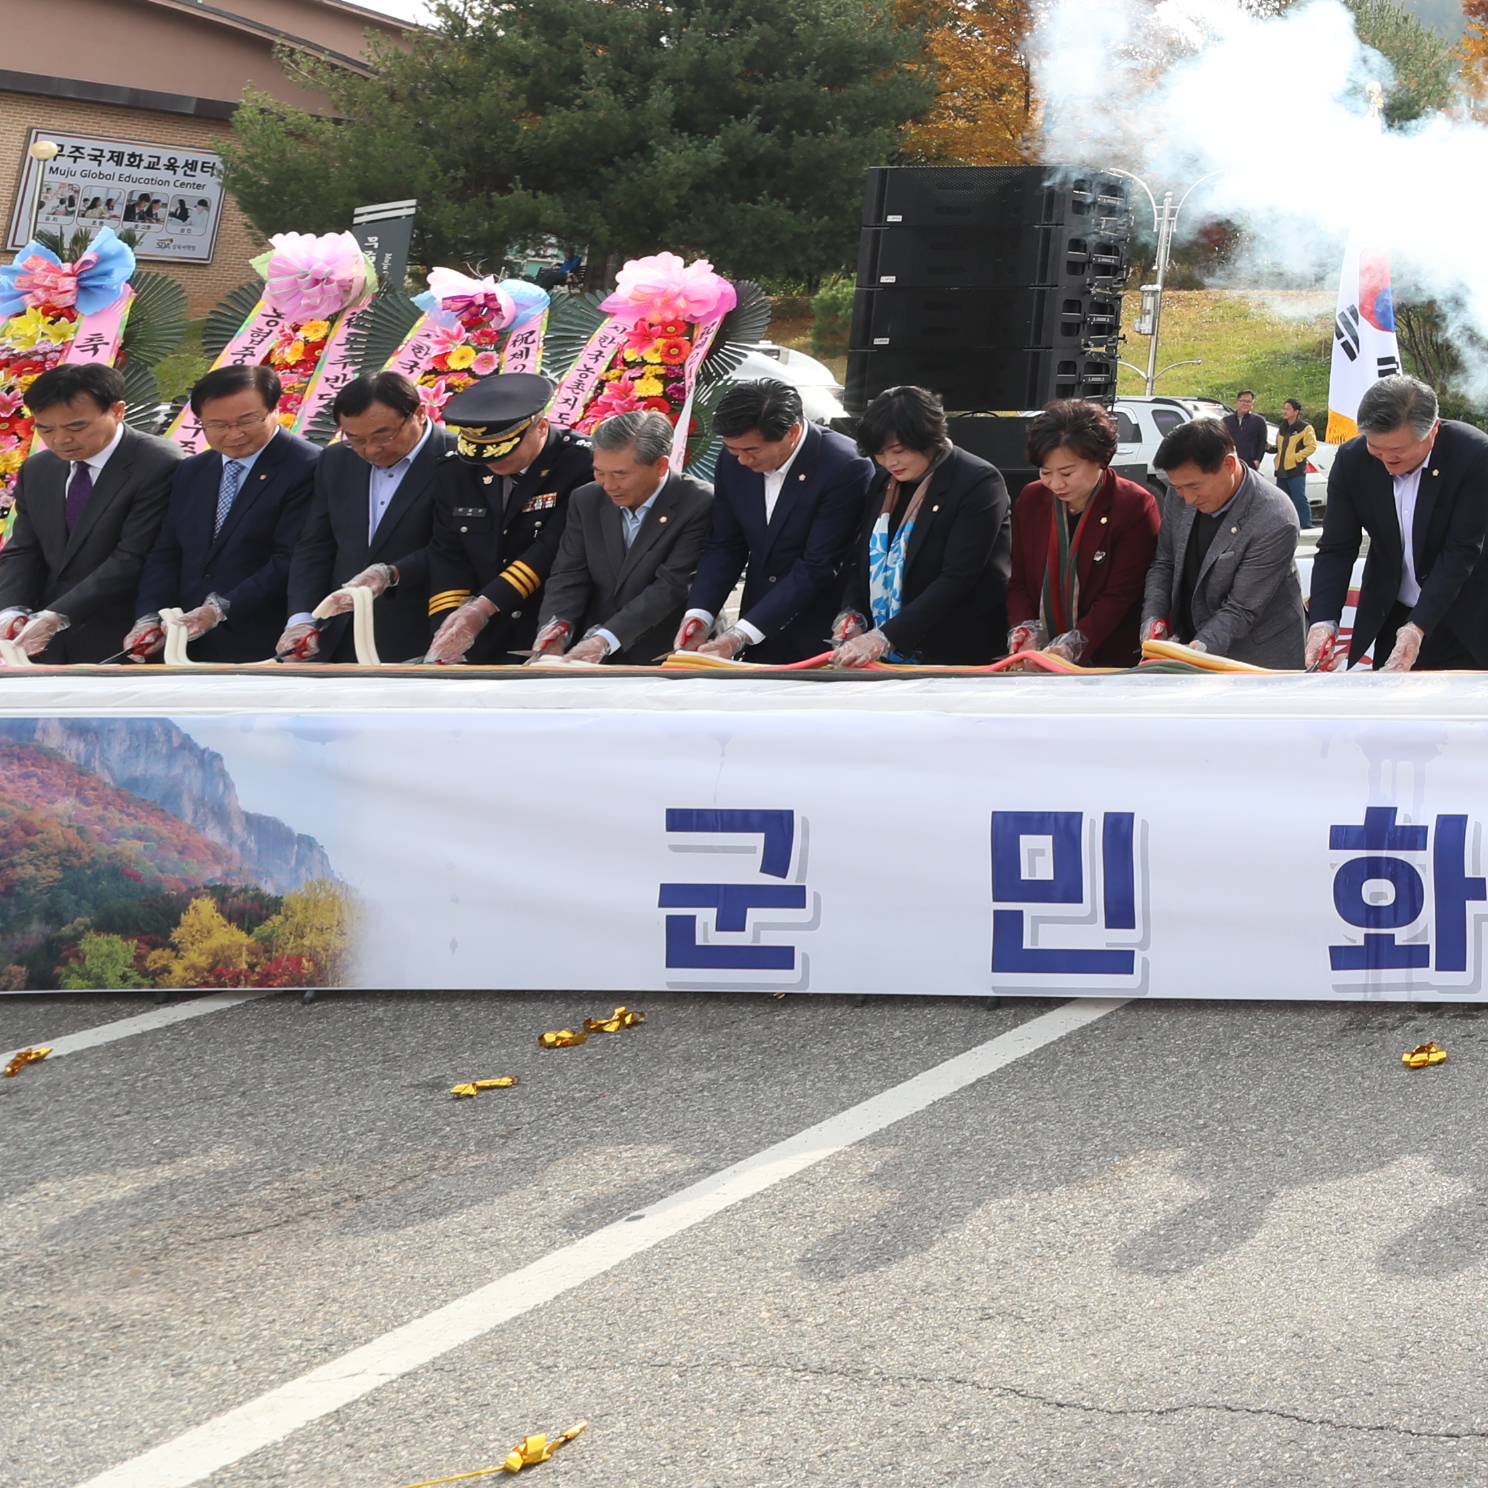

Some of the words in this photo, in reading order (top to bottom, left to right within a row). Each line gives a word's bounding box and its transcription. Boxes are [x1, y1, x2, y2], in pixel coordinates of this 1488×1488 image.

[49, 165, 77, 179] Muju
[79, 169, 116, 182] Global
[118, 173, 170, 188] Education
[173, 179, 207, 191] Center
[156, 241, 171, 249] SDA
